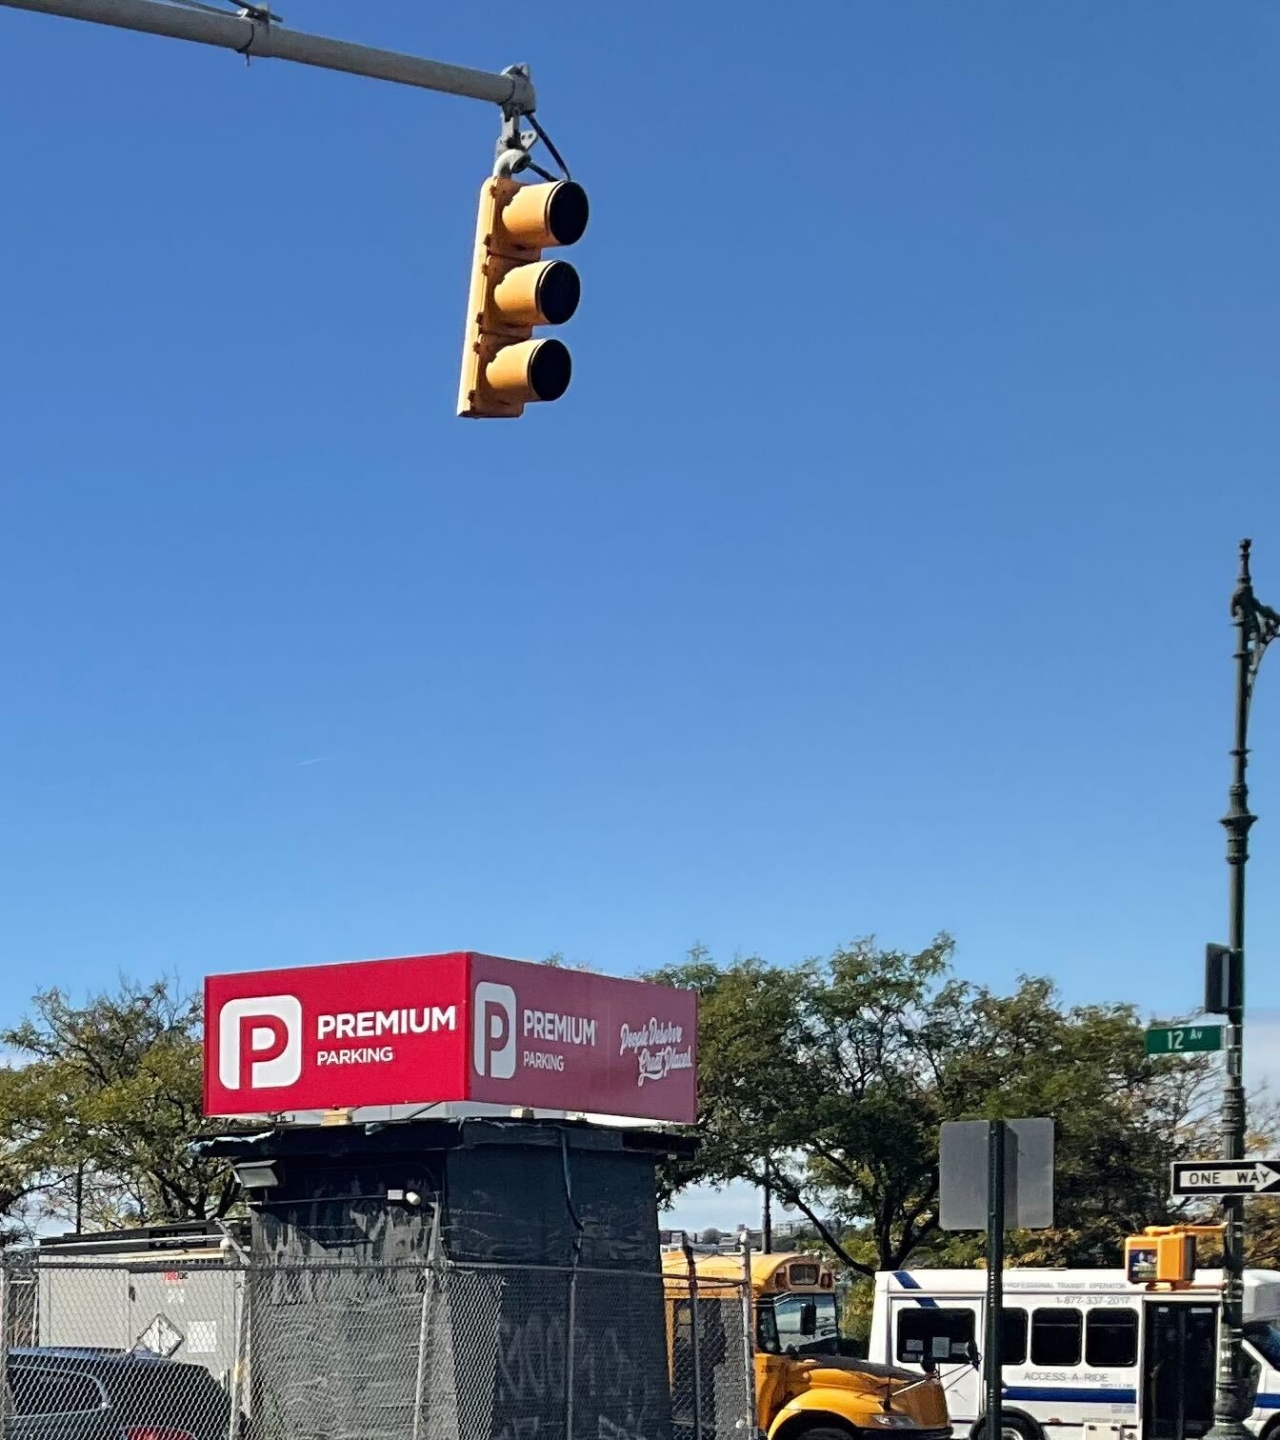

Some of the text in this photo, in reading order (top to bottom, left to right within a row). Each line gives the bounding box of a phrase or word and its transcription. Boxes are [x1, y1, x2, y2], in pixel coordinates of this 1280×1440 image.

[317, 1005, 456, 1040] PREMIUM
[523, 1009, 595, 1047] PREMIUM
[620, 1023, 648, 1056] People
[1166, 1029, 1203, 1050] 12 Av
[317, 1047, 394, 1066] PARKING
[523, 1051, 565, 1072] PARKING
[1190, 1171, 1271, 1185] ONE WAY
